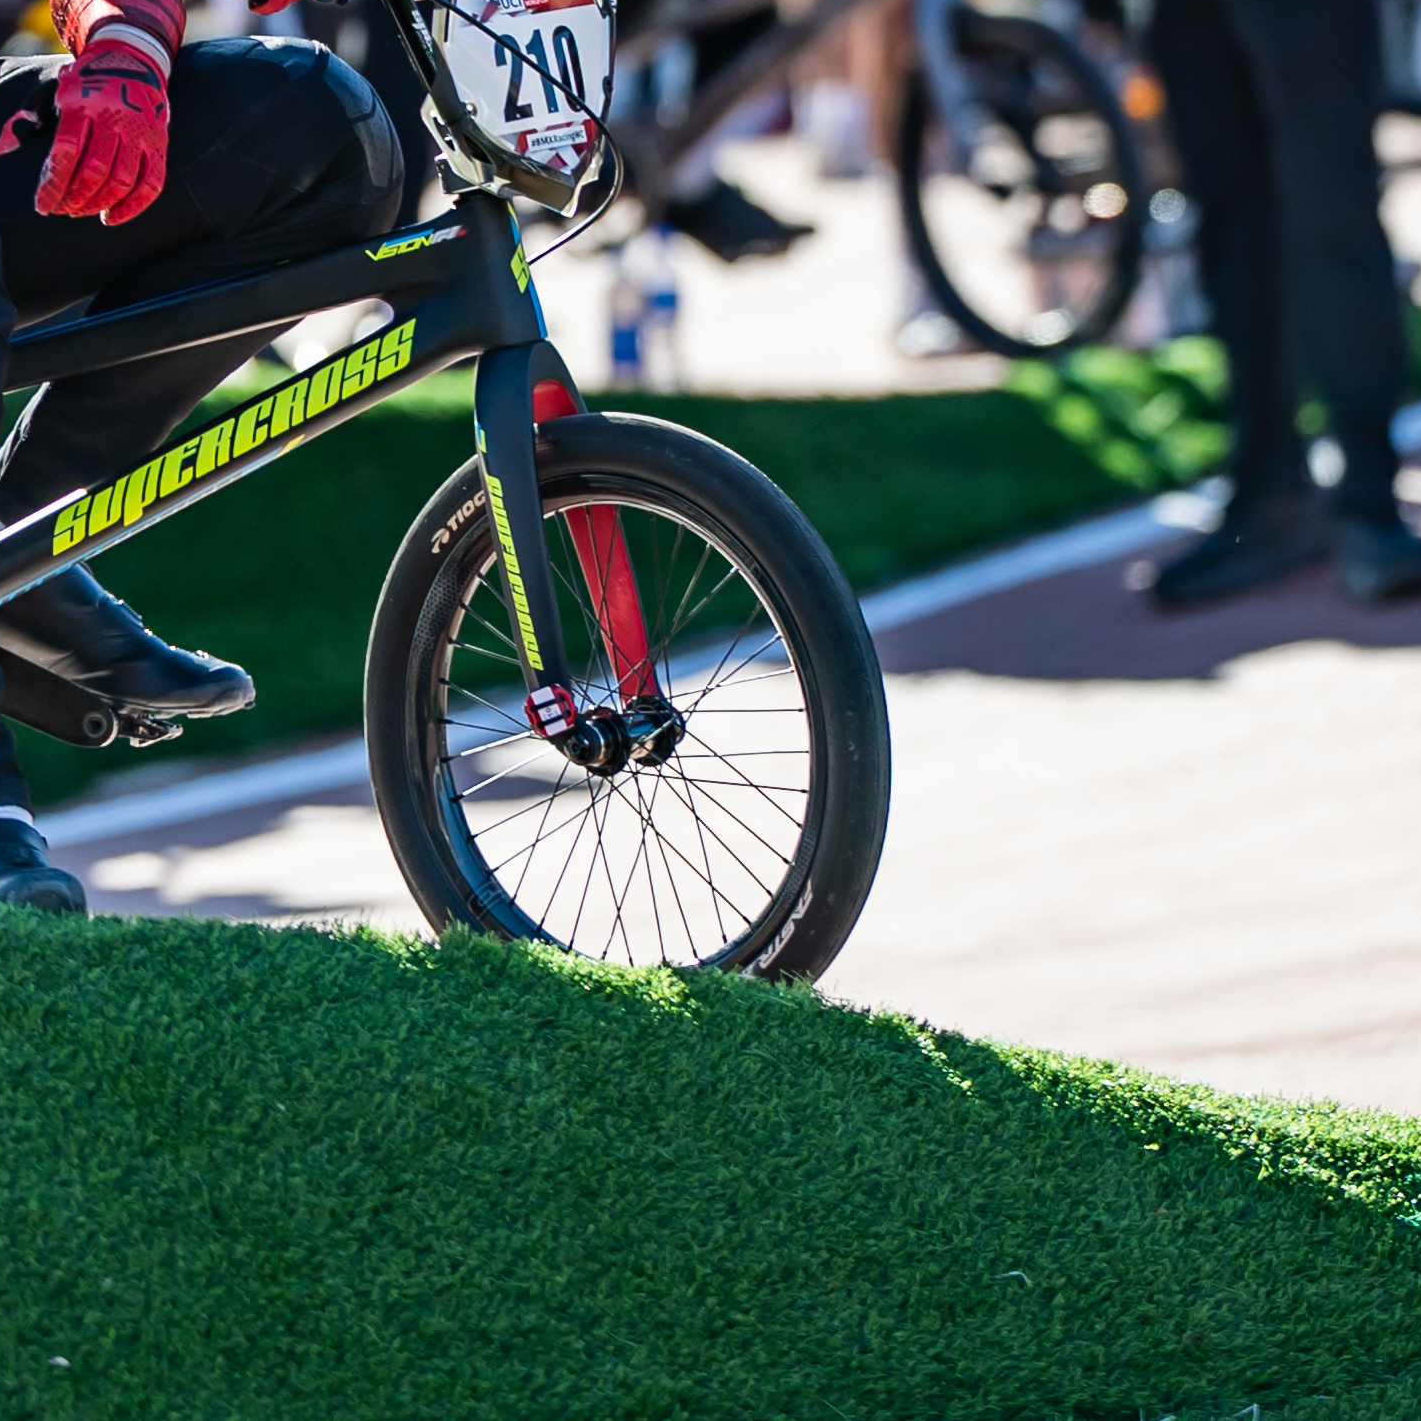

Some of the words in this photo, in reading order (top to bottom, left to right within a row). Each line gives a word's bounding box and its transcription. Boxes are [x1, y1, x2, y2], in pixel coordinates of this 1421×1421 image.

[494, 25, 586, 123] 210
[52, 319, 417, 557] SUPERCROSS
[446, 490, 487, 531] TIOG
